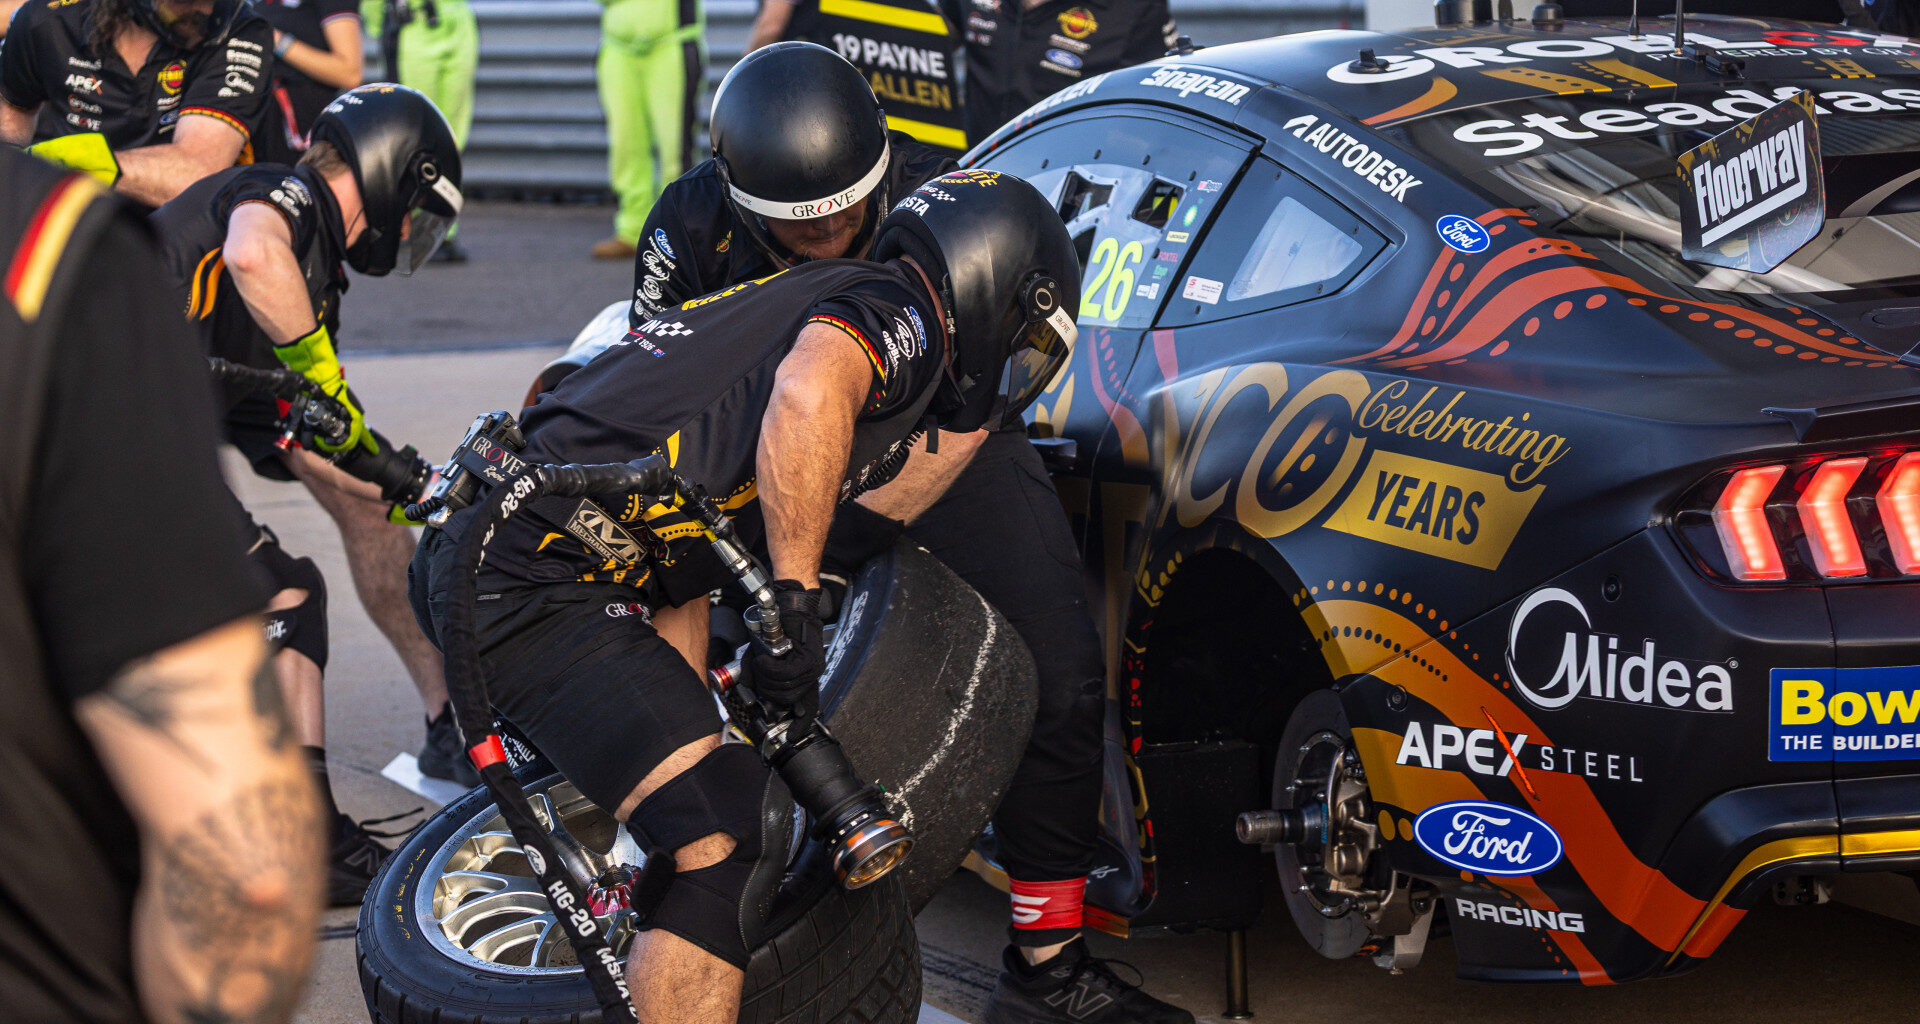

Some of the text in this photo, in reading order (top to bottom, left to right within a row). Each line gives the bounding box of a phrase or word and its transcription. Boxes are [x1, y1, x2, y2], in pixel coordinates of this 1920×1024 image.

[832, 32, 861, 62] 19
[861, 38, 948, 79] PAYNE
[1646, 47, 1808, 61] POERED
[1810, 47, 1853, 56] BY
[65, 74, 102, 95] APEX
[870, 70, 953, 111] ALLEN
[1140, 66, 1250, 106] Snap-on
[66, 112, 102, 131] GROVE
[1304, 123, 1423, 203] AUTODESK
[1693, 120, 1807, 229] Floorway
[792, 189, 856, 217] GROVE
[1441, 218, 1483, 250] Ford
[1079, 237, 1143, 322] 26
[1359, 379, 1571, 484] Celebrating
[472, 436, 527, 477] GROVE
[1366, 469, 1486, 546] YEARS
[1508, 588, 1733, 711] Midea
[1781, 679, 1920, 726] Bow
[1396, 720, 1643, 783] APEX STEEL
[1781, 735, 1823, 750] THE
[1434, 806, 1542, 870] Ford
[548, 879, 597, 938] HG-20
[1455, 898, 1585, 933] RACING
